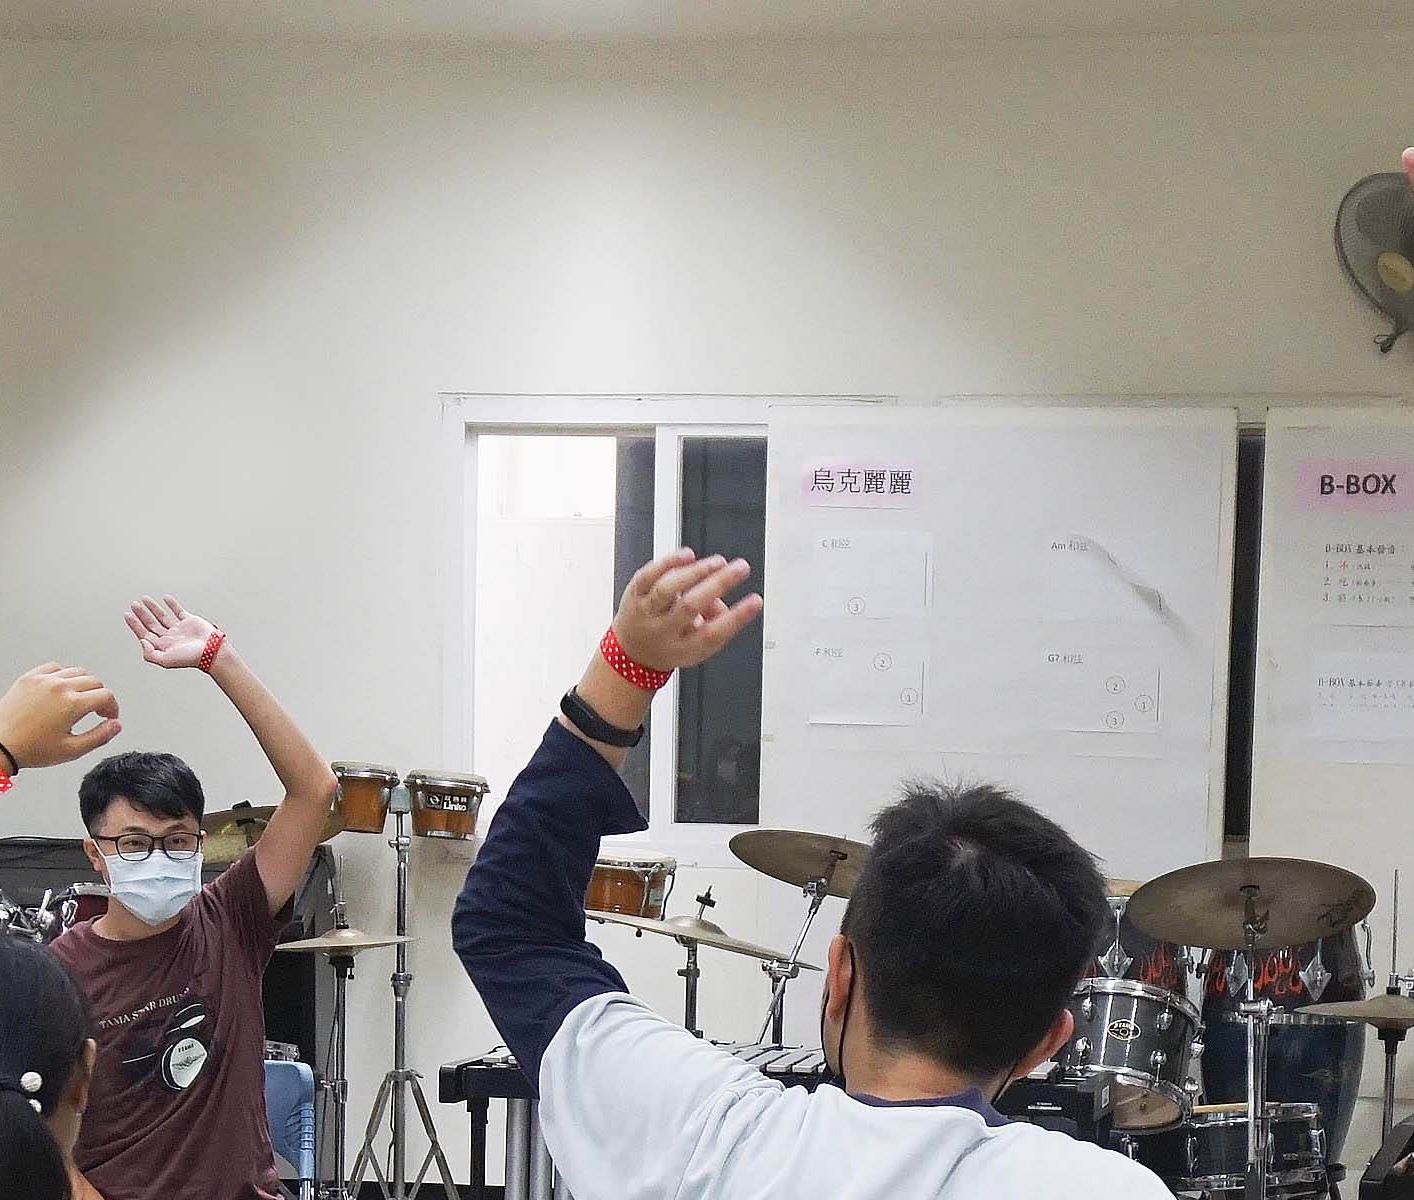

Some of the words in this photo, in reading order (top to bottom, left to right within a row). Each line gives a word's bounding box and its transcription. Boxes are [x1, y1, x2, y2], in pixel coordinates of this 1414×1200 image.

[811, 467, 913, 495] 烏克麗麗
[1320, 474, 1397, 495] B-BOX
